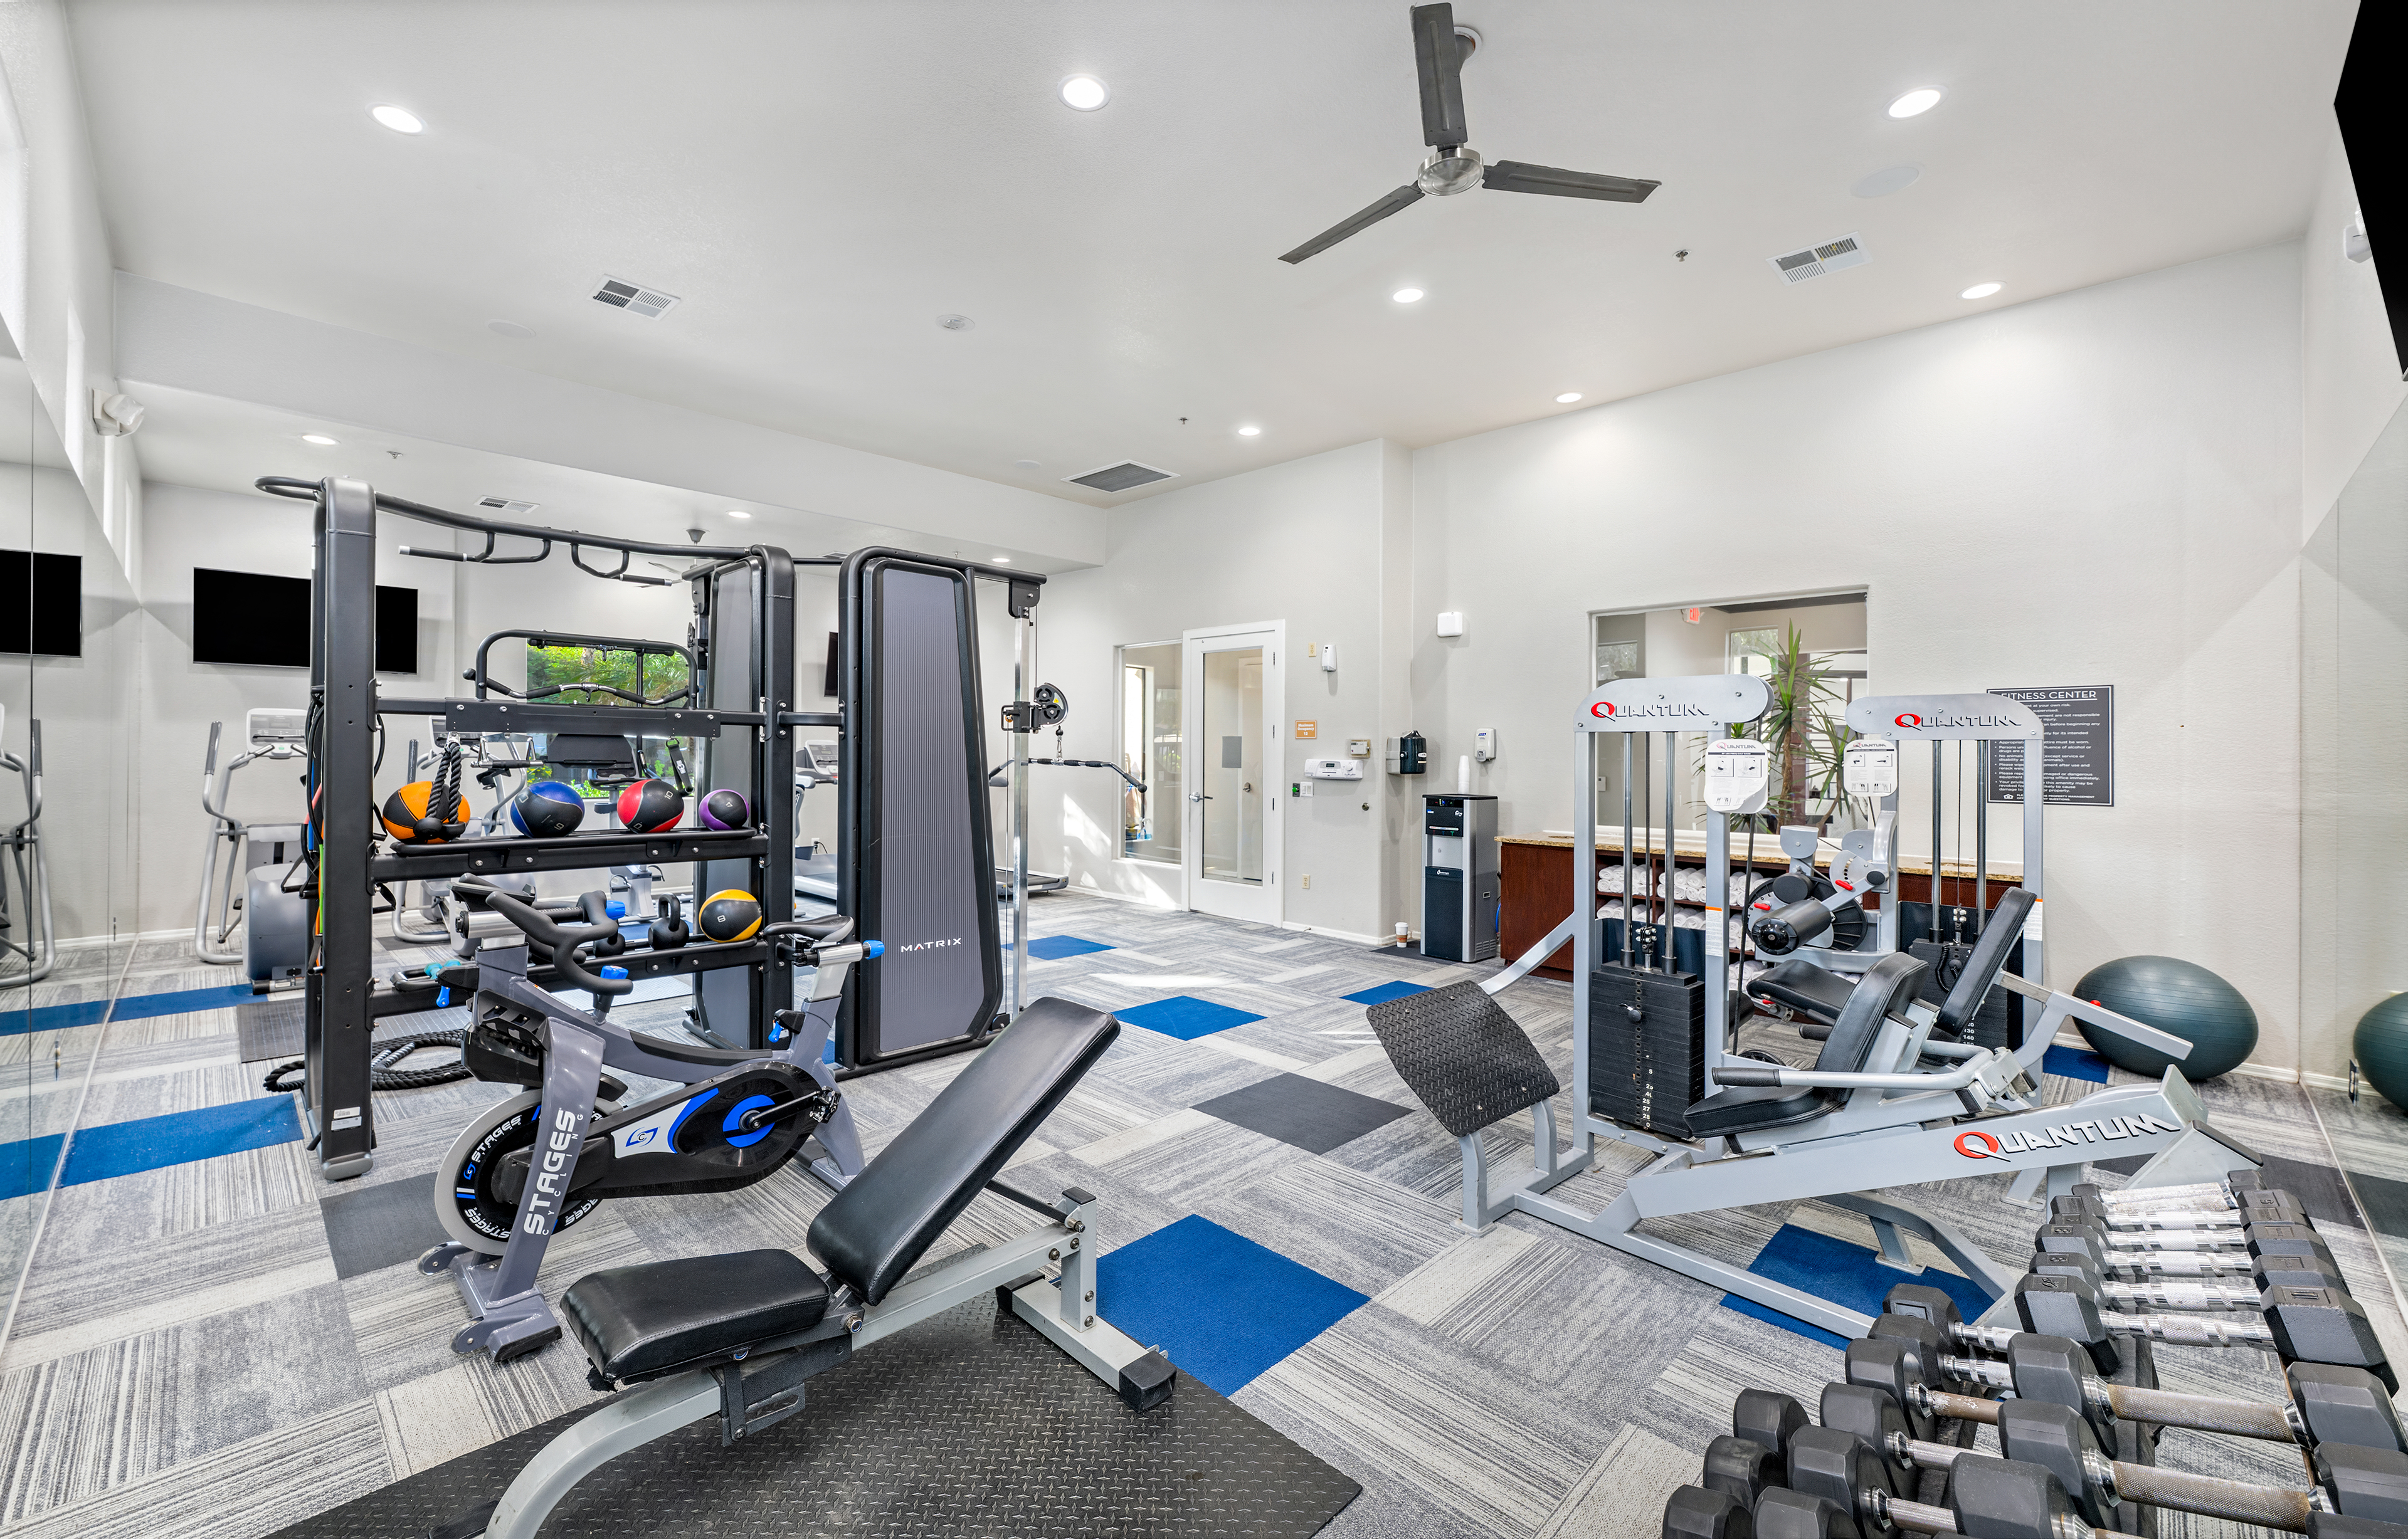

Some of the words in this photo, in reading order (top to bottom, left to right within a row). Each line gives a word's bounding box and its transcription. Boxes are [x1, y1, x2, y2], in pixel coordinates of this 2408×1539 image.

[2049, 690, 2096, 699] CENTER
[1591, 701, 1709, 722] QUANTUM
[1894, 713, 2022, 731] QUANTUM
[1716, 742, 1756, 750] QUANTUM
[664, 790, 673, 800] 10
[717, 915, 726, 923] 8
[901, 937, 961, 953] MATRIX
[472, 1115, 521, 1162] STAGES
[1953, 1113, 2181, 1162] QUANTUM
[524, 1109, 576, 1235] STAGES
[542, 1113, 584, 1236] CYCLING
[566, 1199, 598, 1226] AGES
[465, 1208, 512, 1239] STAGES
